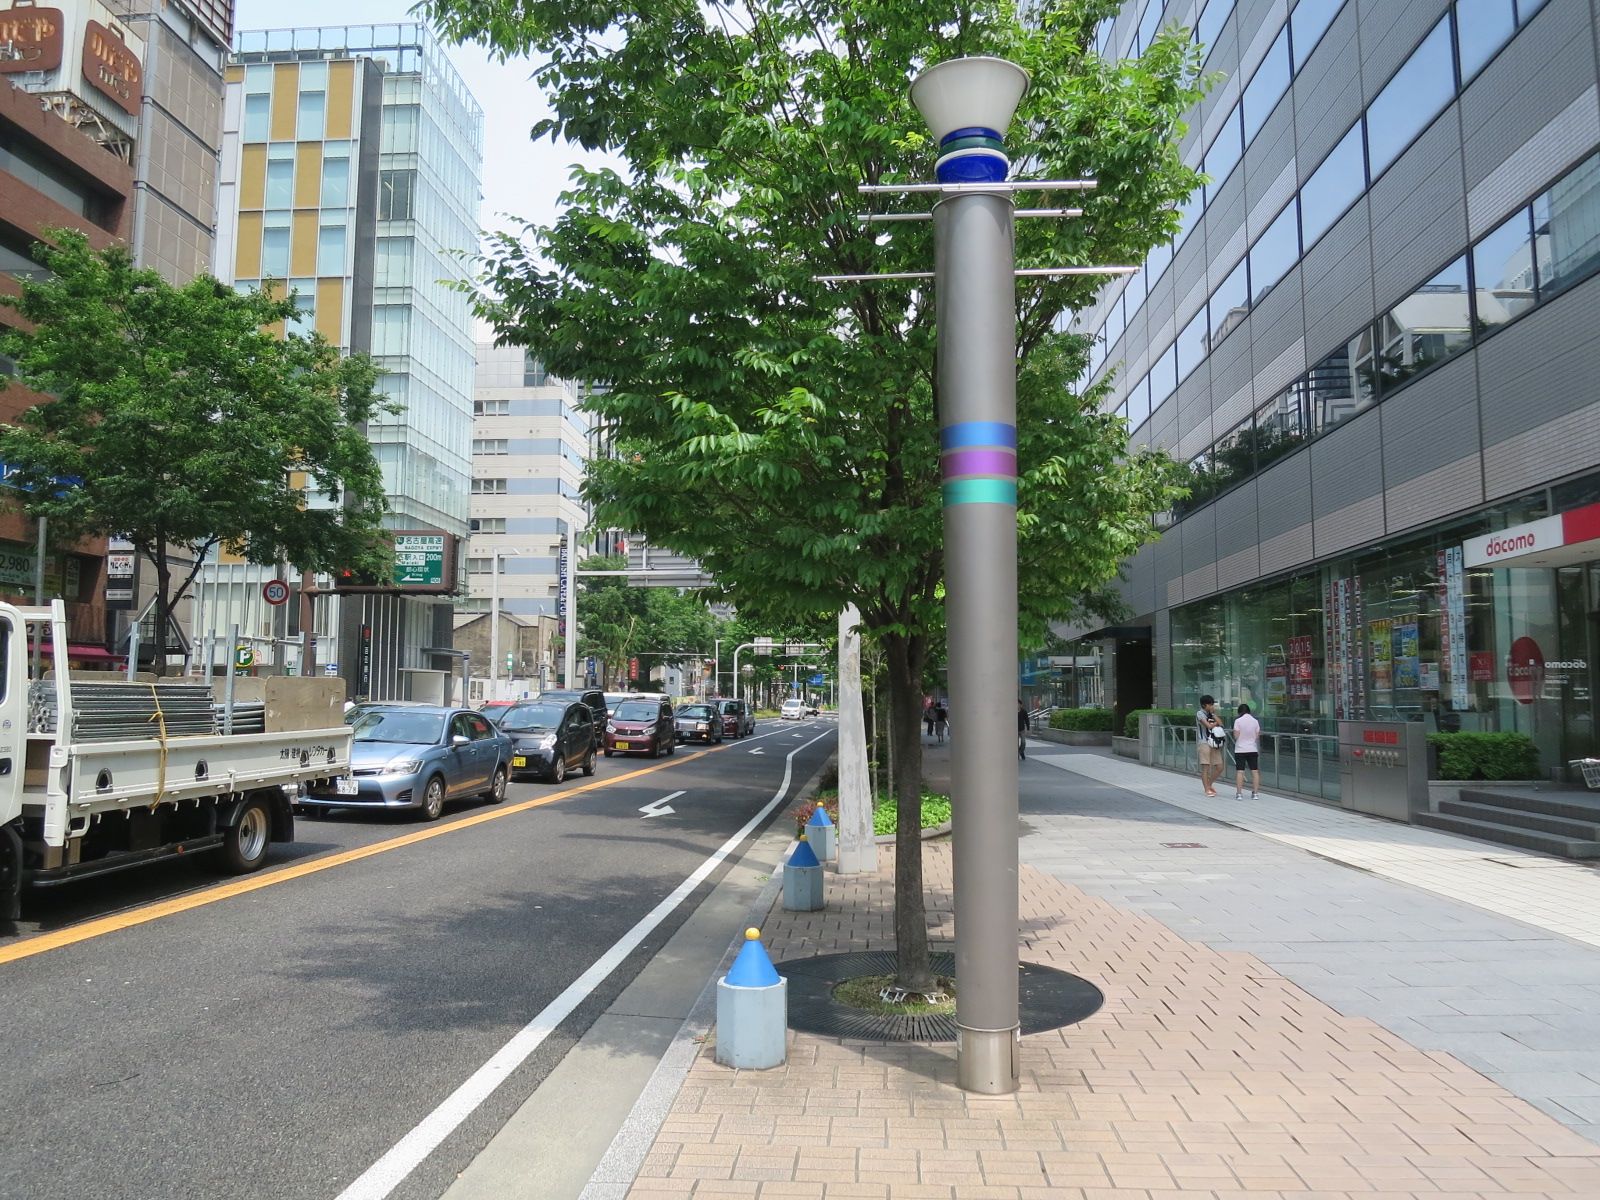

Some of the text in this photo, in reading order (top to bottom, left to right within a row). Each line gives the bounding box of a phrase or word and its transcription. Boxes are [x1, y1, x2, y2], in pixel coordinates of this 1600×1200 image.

[405, 536, 442, 545] 名古屋高速
[1486, 533, 1535, 557] docomo
[426, 553, 442, 561] 200m
[268, 587, 284, 598] 50
[1289, 641, 1311, 653] 2015
[239, 649, 251, 663] P
